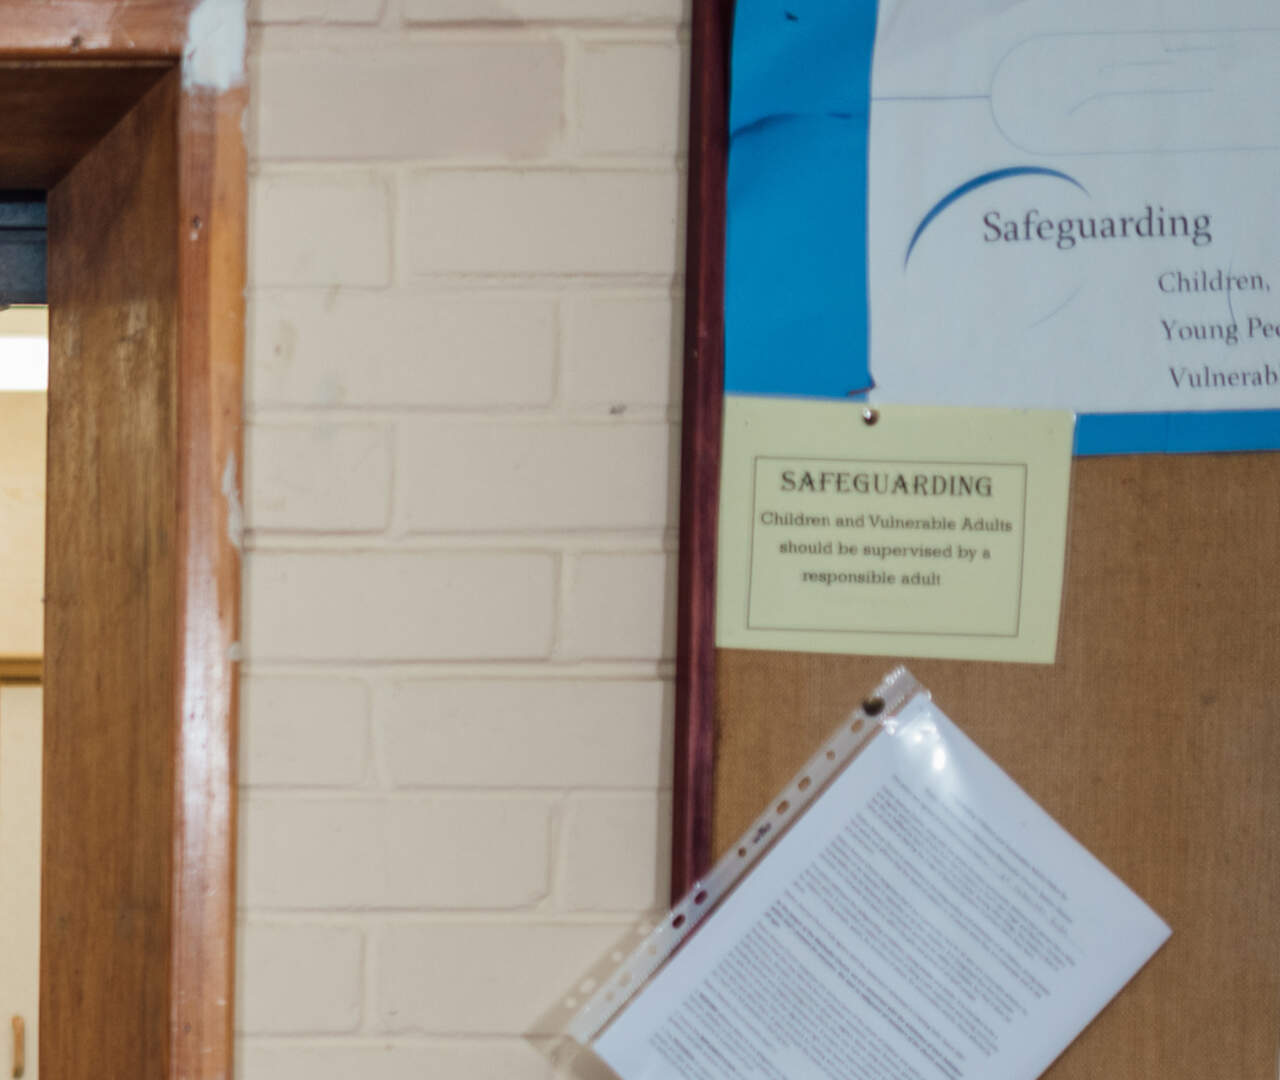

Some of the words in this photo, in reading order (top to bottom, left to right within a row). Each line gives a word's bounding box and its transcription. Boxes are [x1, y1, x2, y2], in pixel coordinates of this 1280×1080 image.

[982, 203, 1212, 249] Safeguarding
[1158, 269, 1271, 294] Children,
[1161, 317, 1239, 346] Young
[780, 471, 993, 498] SAFEGUARDING
[760, 511, 831, 528] Children
[835, 514, 865, 529] and
[869, 514, 956, 531] Vulnerable
[961, 516, 1013, 533] Adults
[779, 540, 833, 556] should
[837, 541, 858, 556] be
[863, 543, 953, 561] supervised
[957, 545, 977, 562] by
[982, 550, 991, 560] a
[802, 570, 896, 586] responsible
[901, 572, 941, 587] adult
